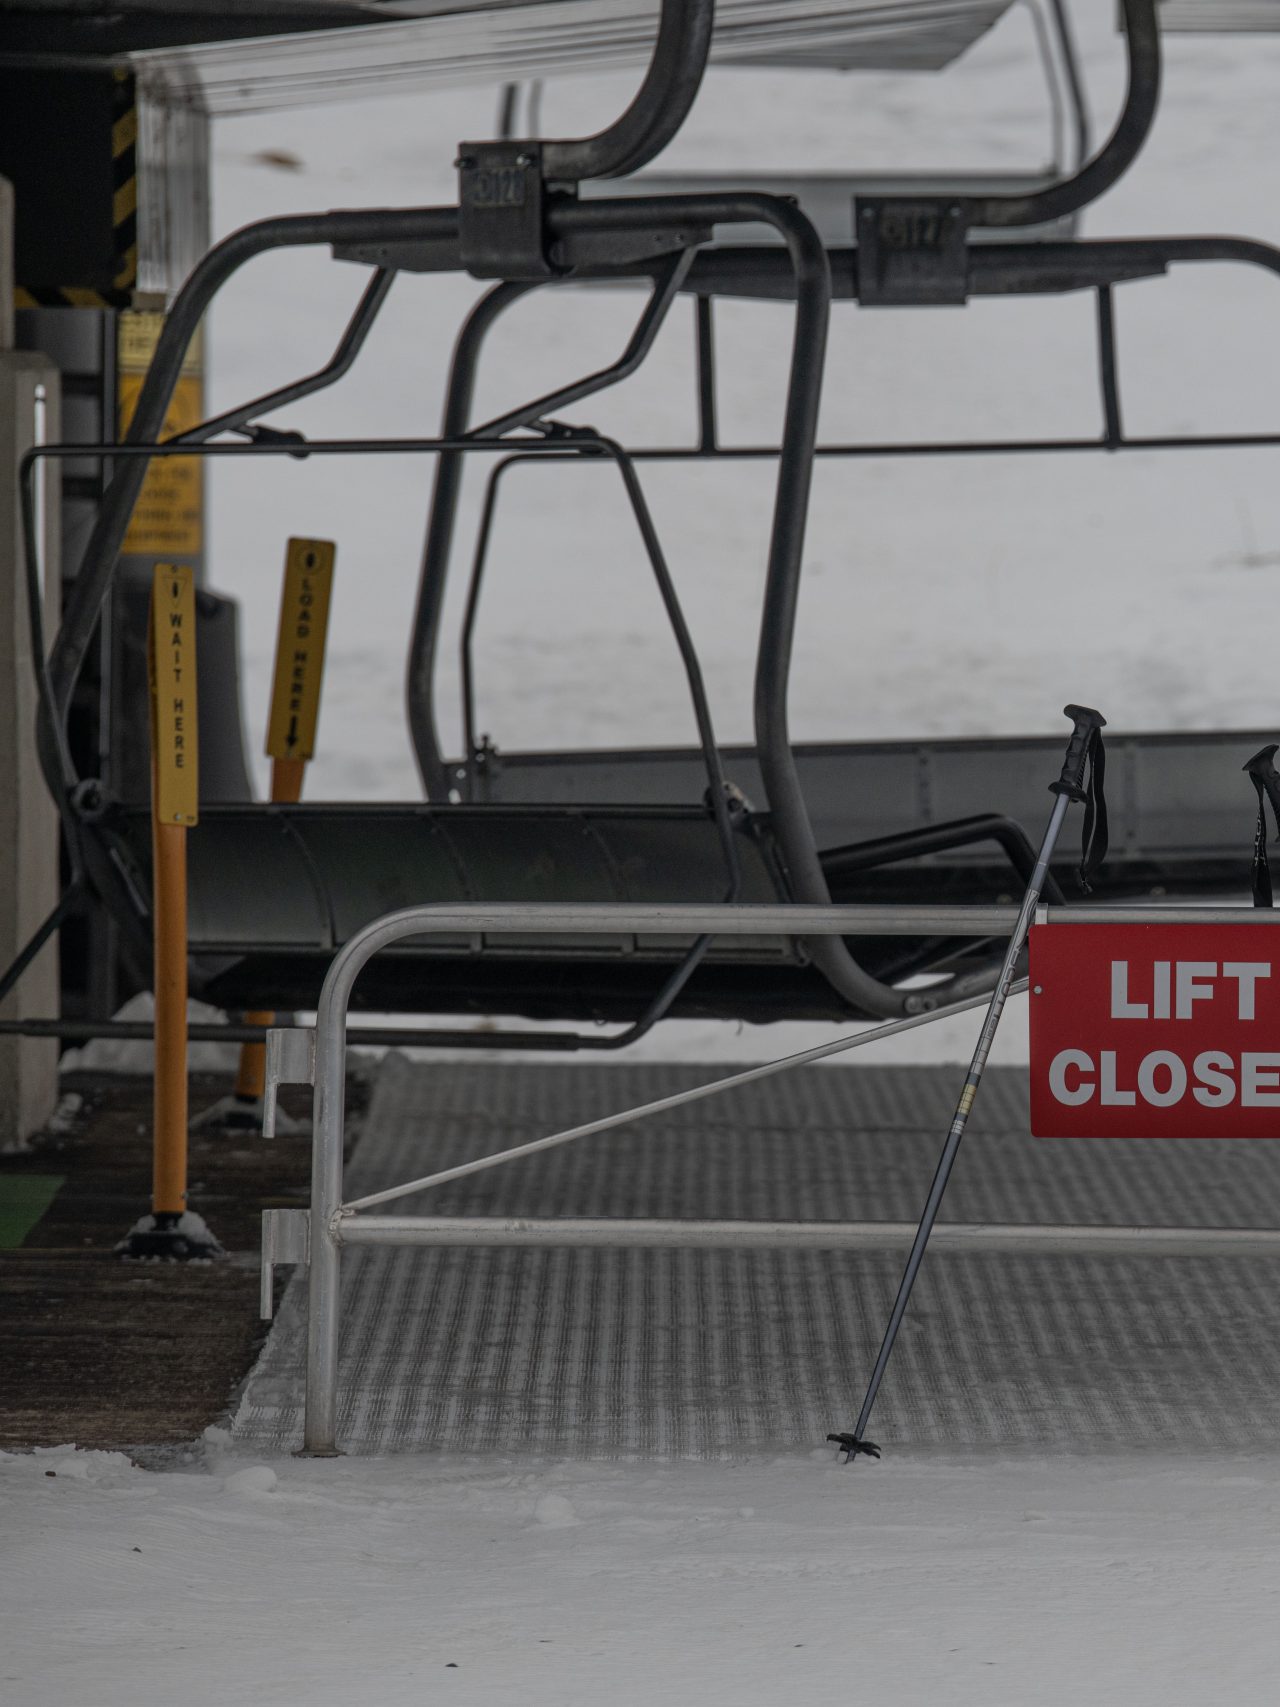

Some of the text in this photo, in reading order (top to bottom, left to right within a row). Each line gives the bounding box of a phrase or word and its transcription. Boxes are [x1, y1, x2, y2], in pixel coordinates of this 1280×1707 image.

[169, 613, 185, 769] WAIT HERE
[290, 578, 313, 711] LOAD HERE
[1111, 960, 1272, 1020] LIFT
